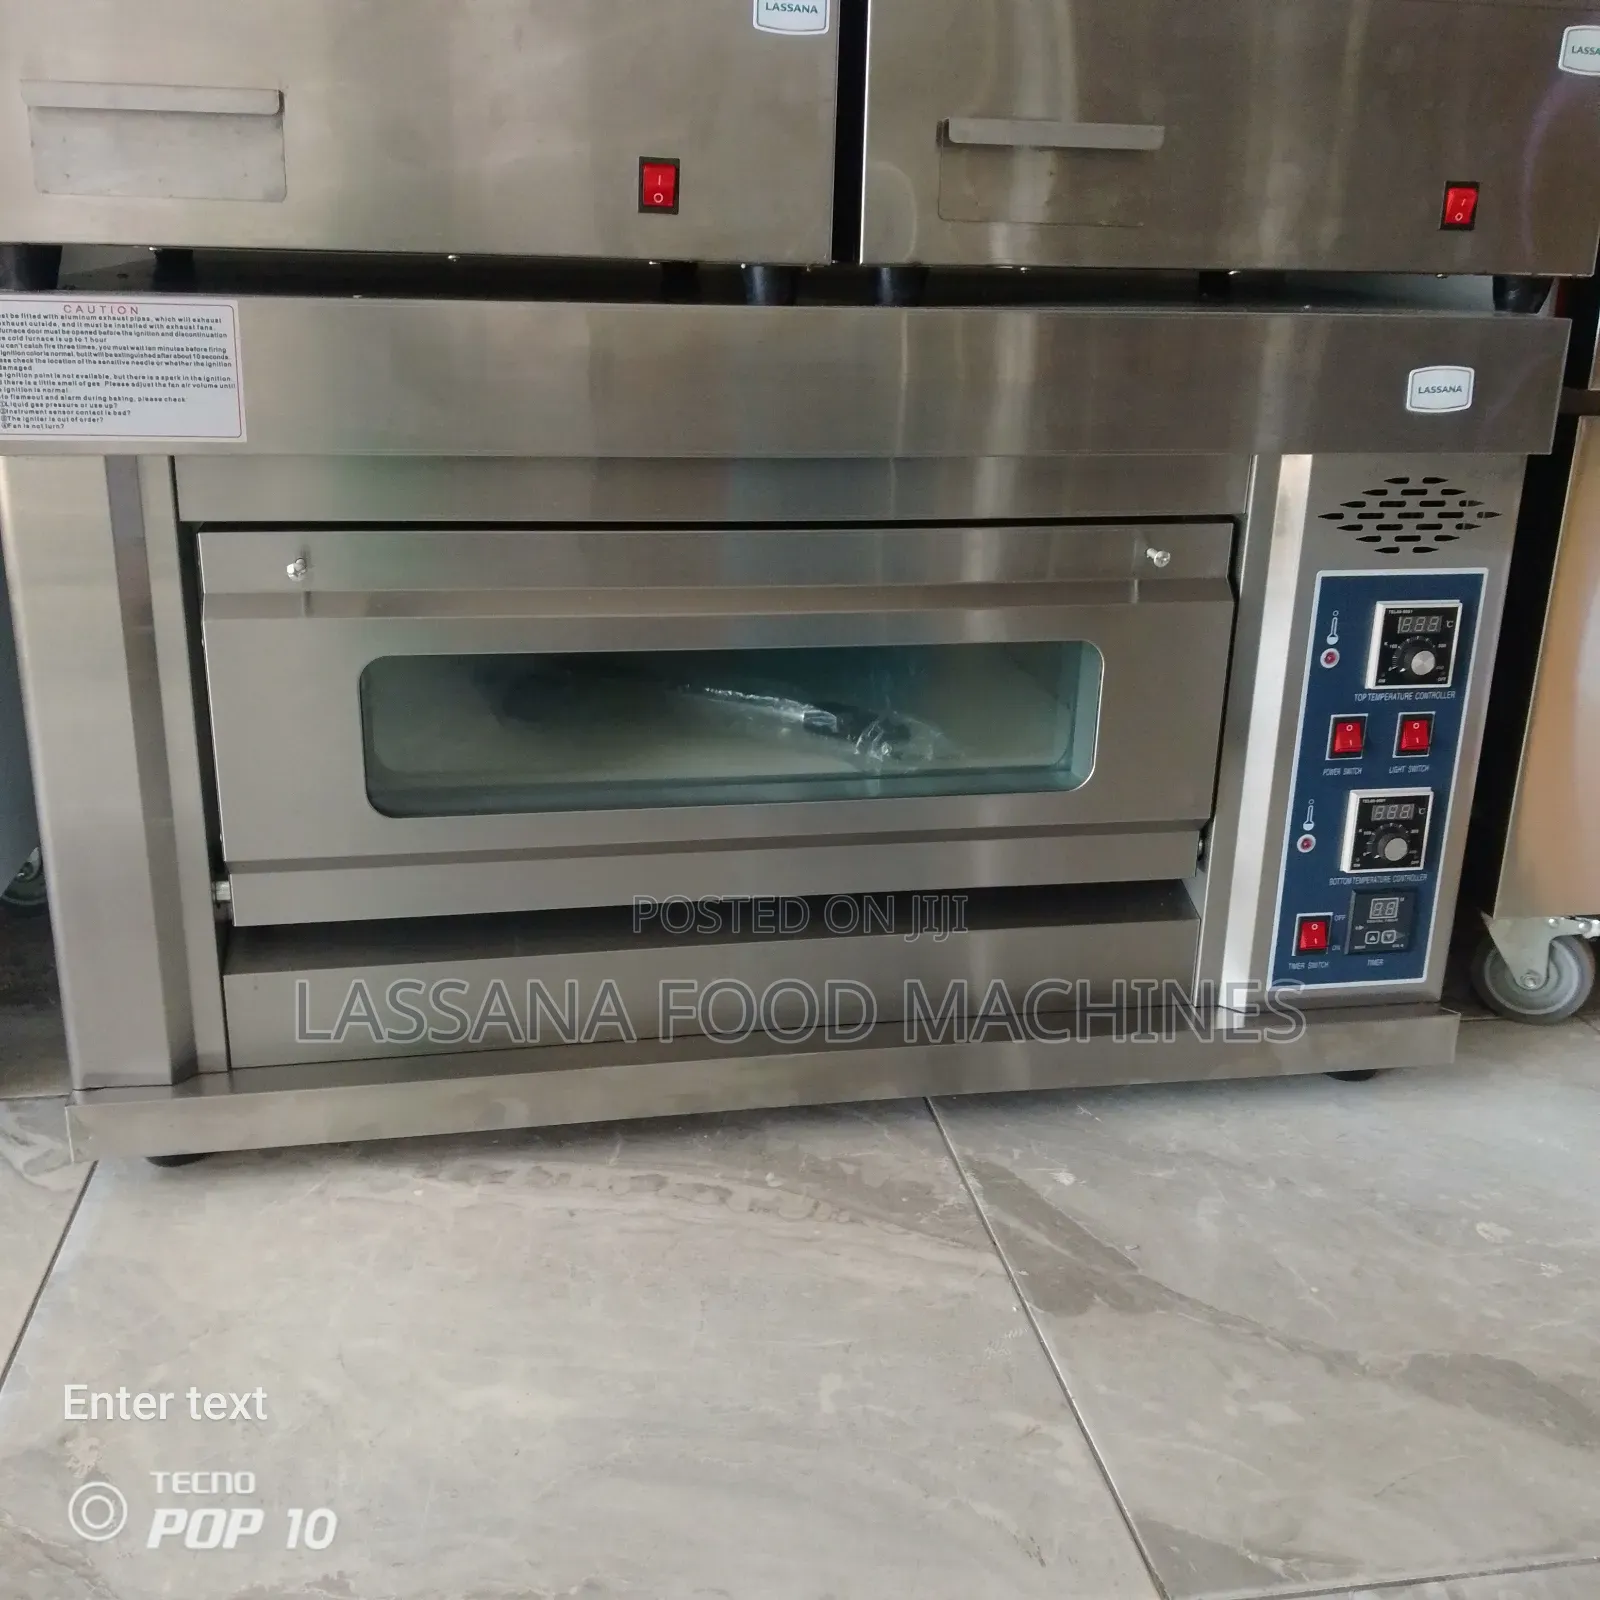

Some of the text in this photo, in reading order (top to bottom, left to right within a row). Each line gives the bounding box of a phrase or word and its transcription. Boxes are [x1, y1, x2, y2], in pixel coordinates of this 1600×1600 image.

[765, 2, 818, 14] LASSANA
[63, 304, 139, 315] CAUTION
[1418, 385, 1463, 394] LASSANA
[1354, 690, 1456, 702] TOP TEMPERATURE CONTROLLER
[1322, 767, 1363, 776] POWER SWITCH
[1389, 765, 1429, 774] LIGHT SWITCH
[1329, 874, 1428, 886] BOTTOM TEMPERATURE CONTROLLER
[1288, 961, 1329, 970] TIMER SWITCH
[1367, 958, 1384, 966] TIMER
